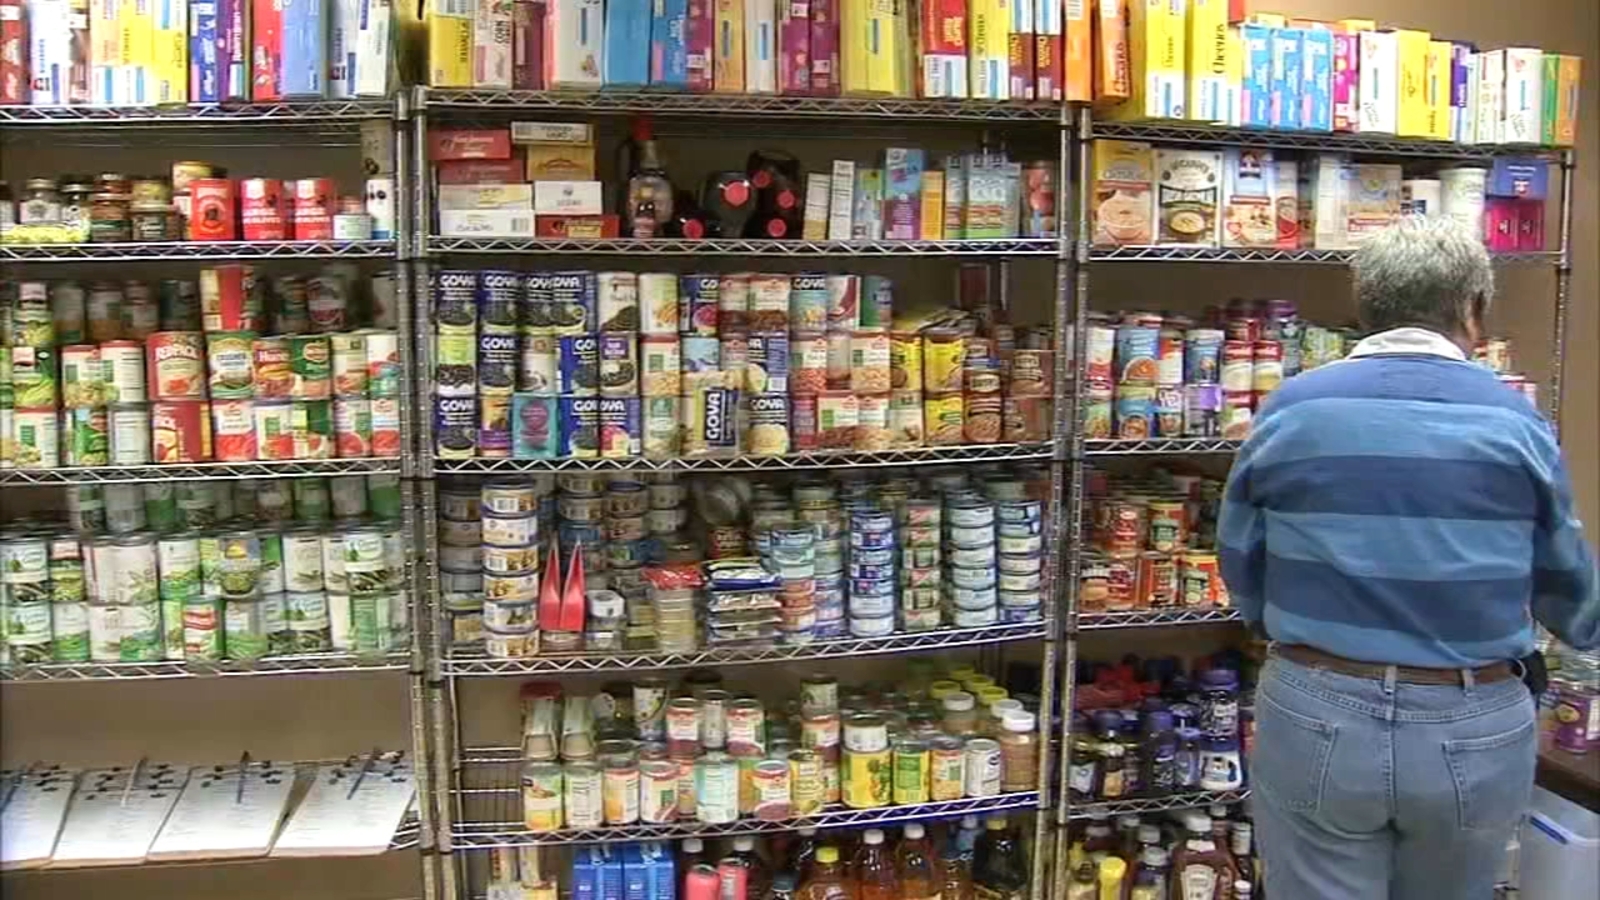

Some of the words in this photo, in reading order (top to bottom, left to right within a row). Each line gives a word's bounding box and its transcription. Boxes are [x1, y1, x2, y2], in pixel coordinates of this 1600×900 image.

[553, 277, 581, 287] OYA
[700, 279, 719, 289] GO
[574, 339, 596, 350] GO
[706, 392, 720, 439] GOYA
